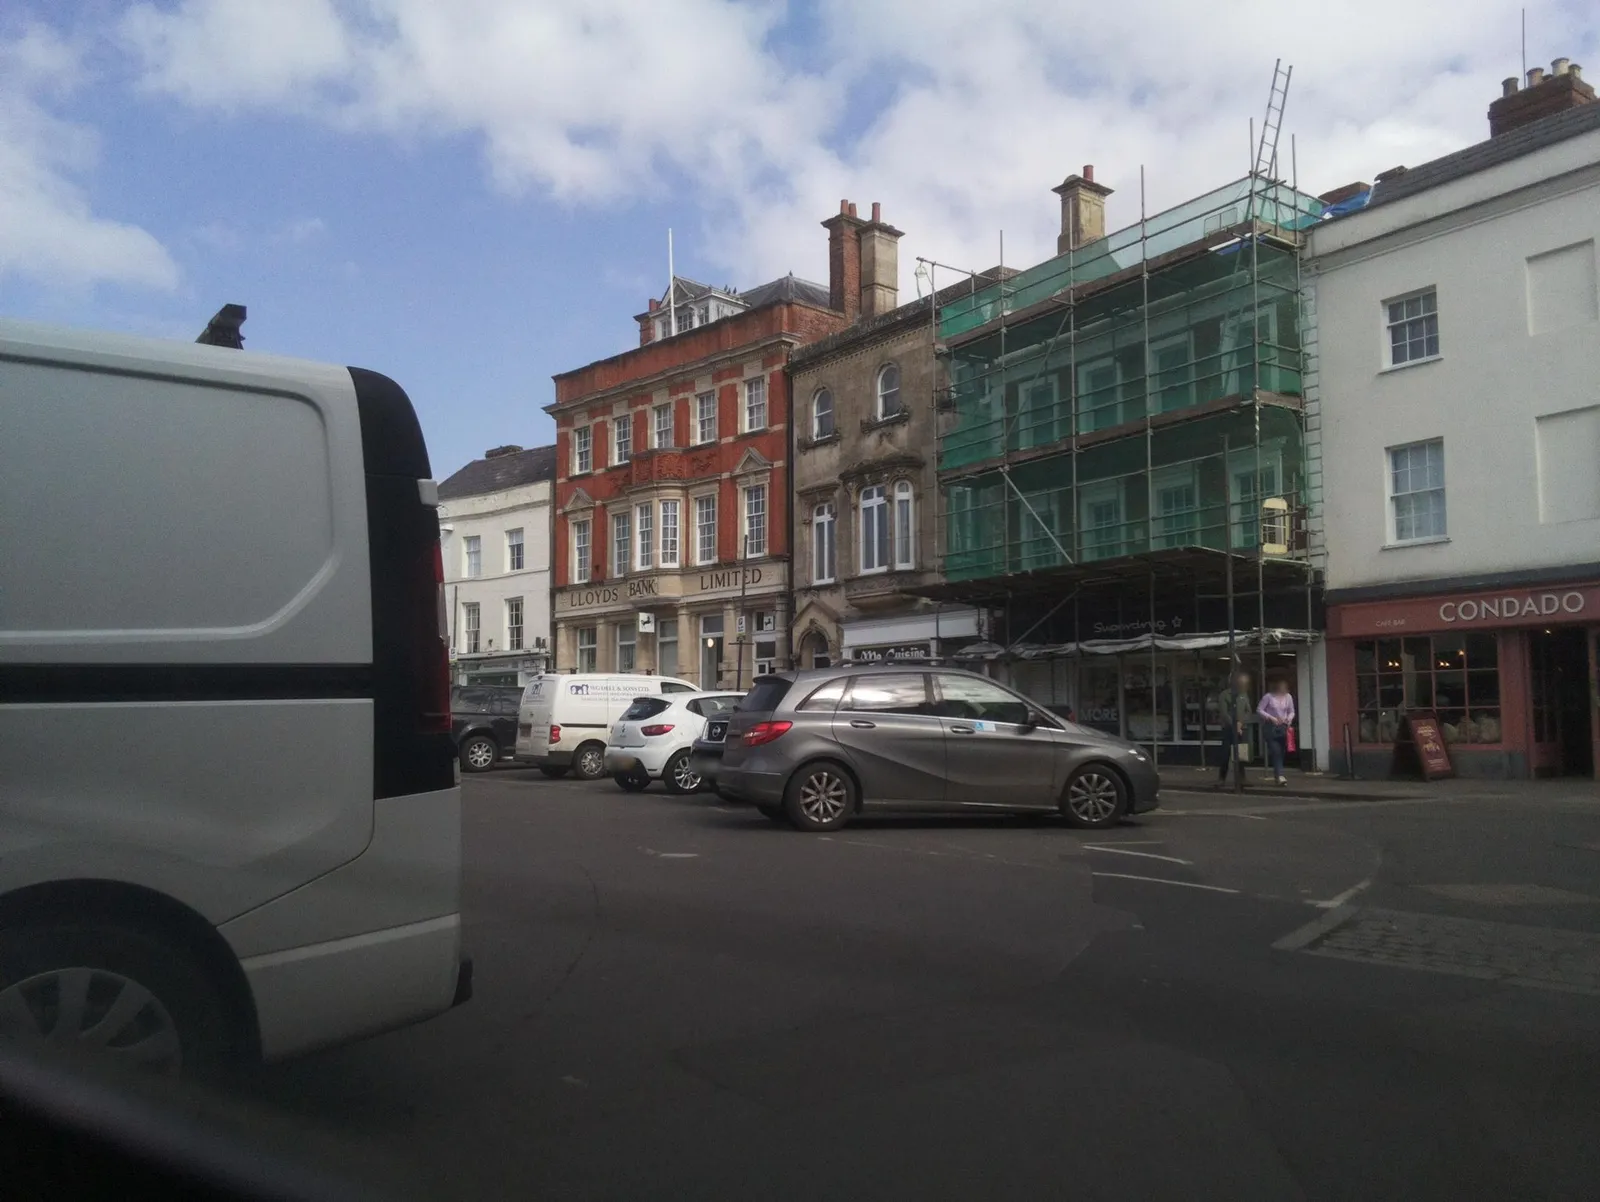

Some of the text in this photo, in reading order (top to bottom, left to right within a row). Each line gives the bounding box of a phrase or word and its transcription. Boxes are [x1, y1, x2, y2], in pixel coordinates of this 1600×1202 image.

[570, 569, 762, 607] LLOYDS BANK LIMITED
[1439, 592, 1585, 622] CONDADO
[1080, 708, 1118, 721] MORE
